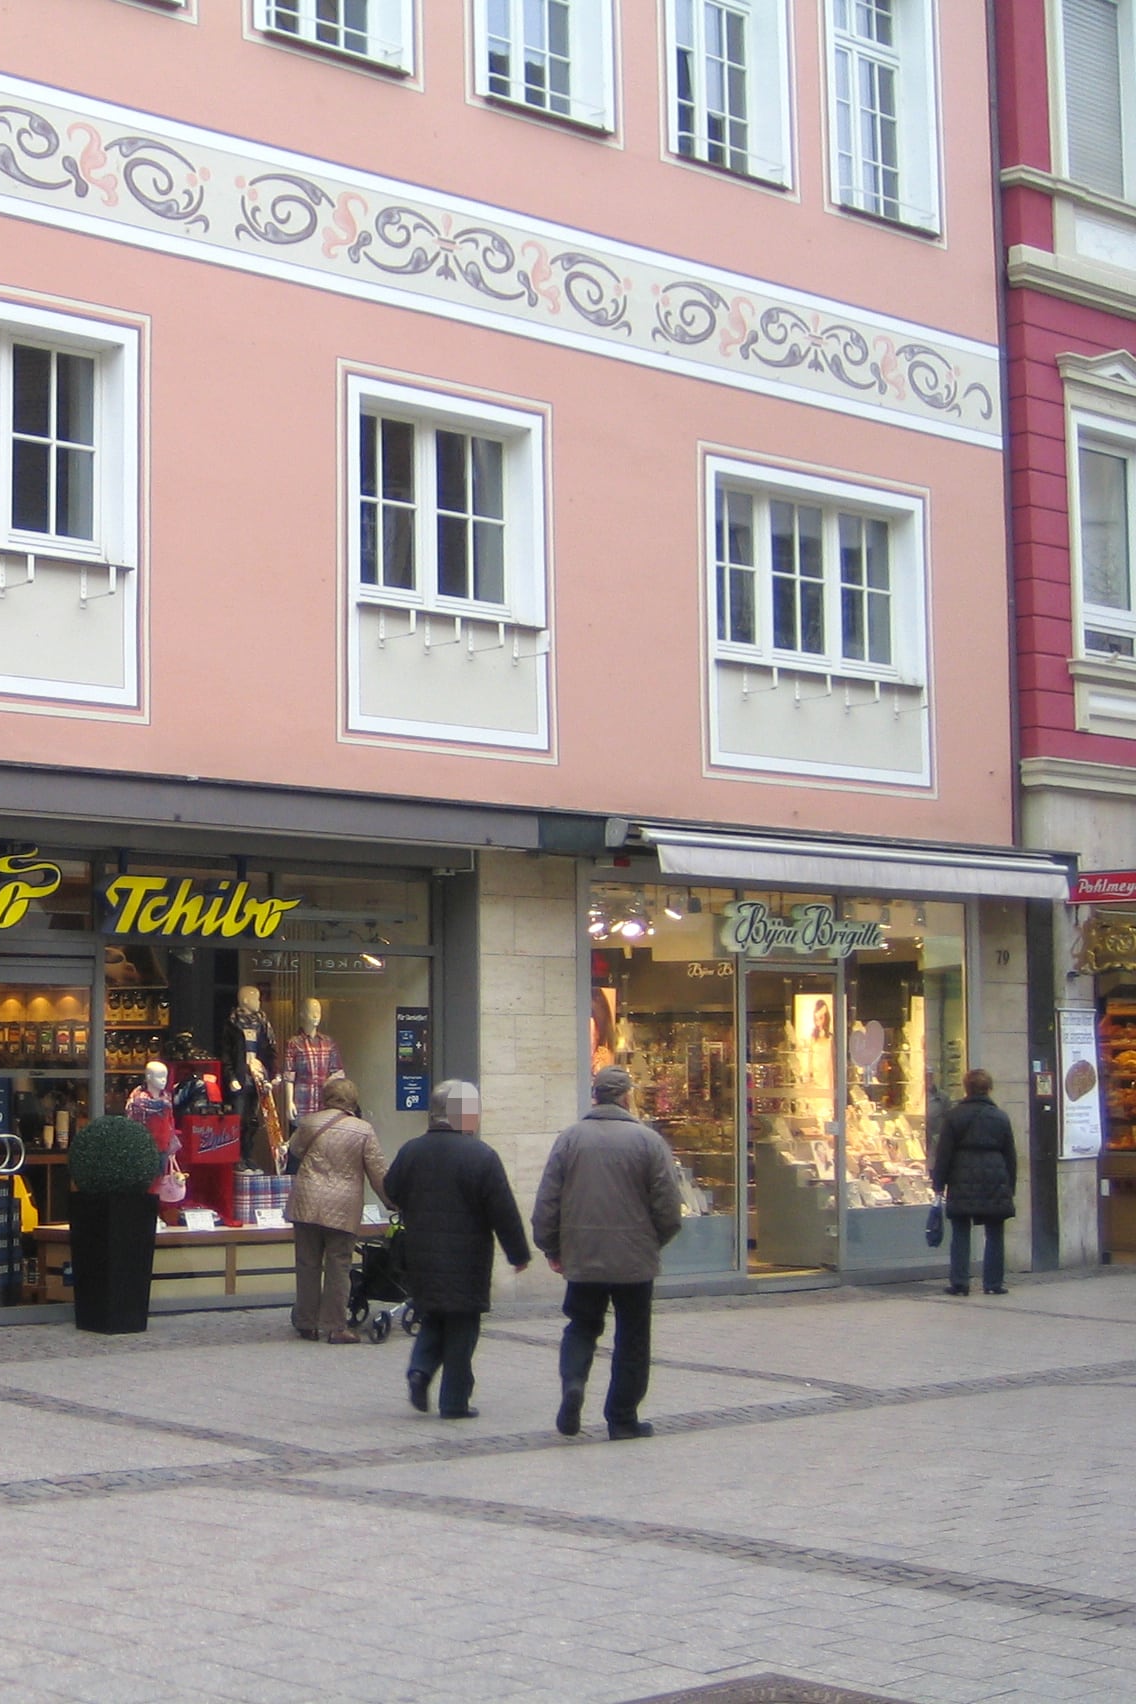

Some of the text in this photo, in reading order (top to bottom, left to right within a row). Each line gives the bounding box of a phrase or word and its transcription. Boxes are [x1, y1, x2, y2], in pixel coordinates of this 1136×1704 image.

[105, 875, 301, 938] Tchibo
[1078, 878, 1136, 898] Pohlmey
[802, 905, 881, 956] Brigitte
